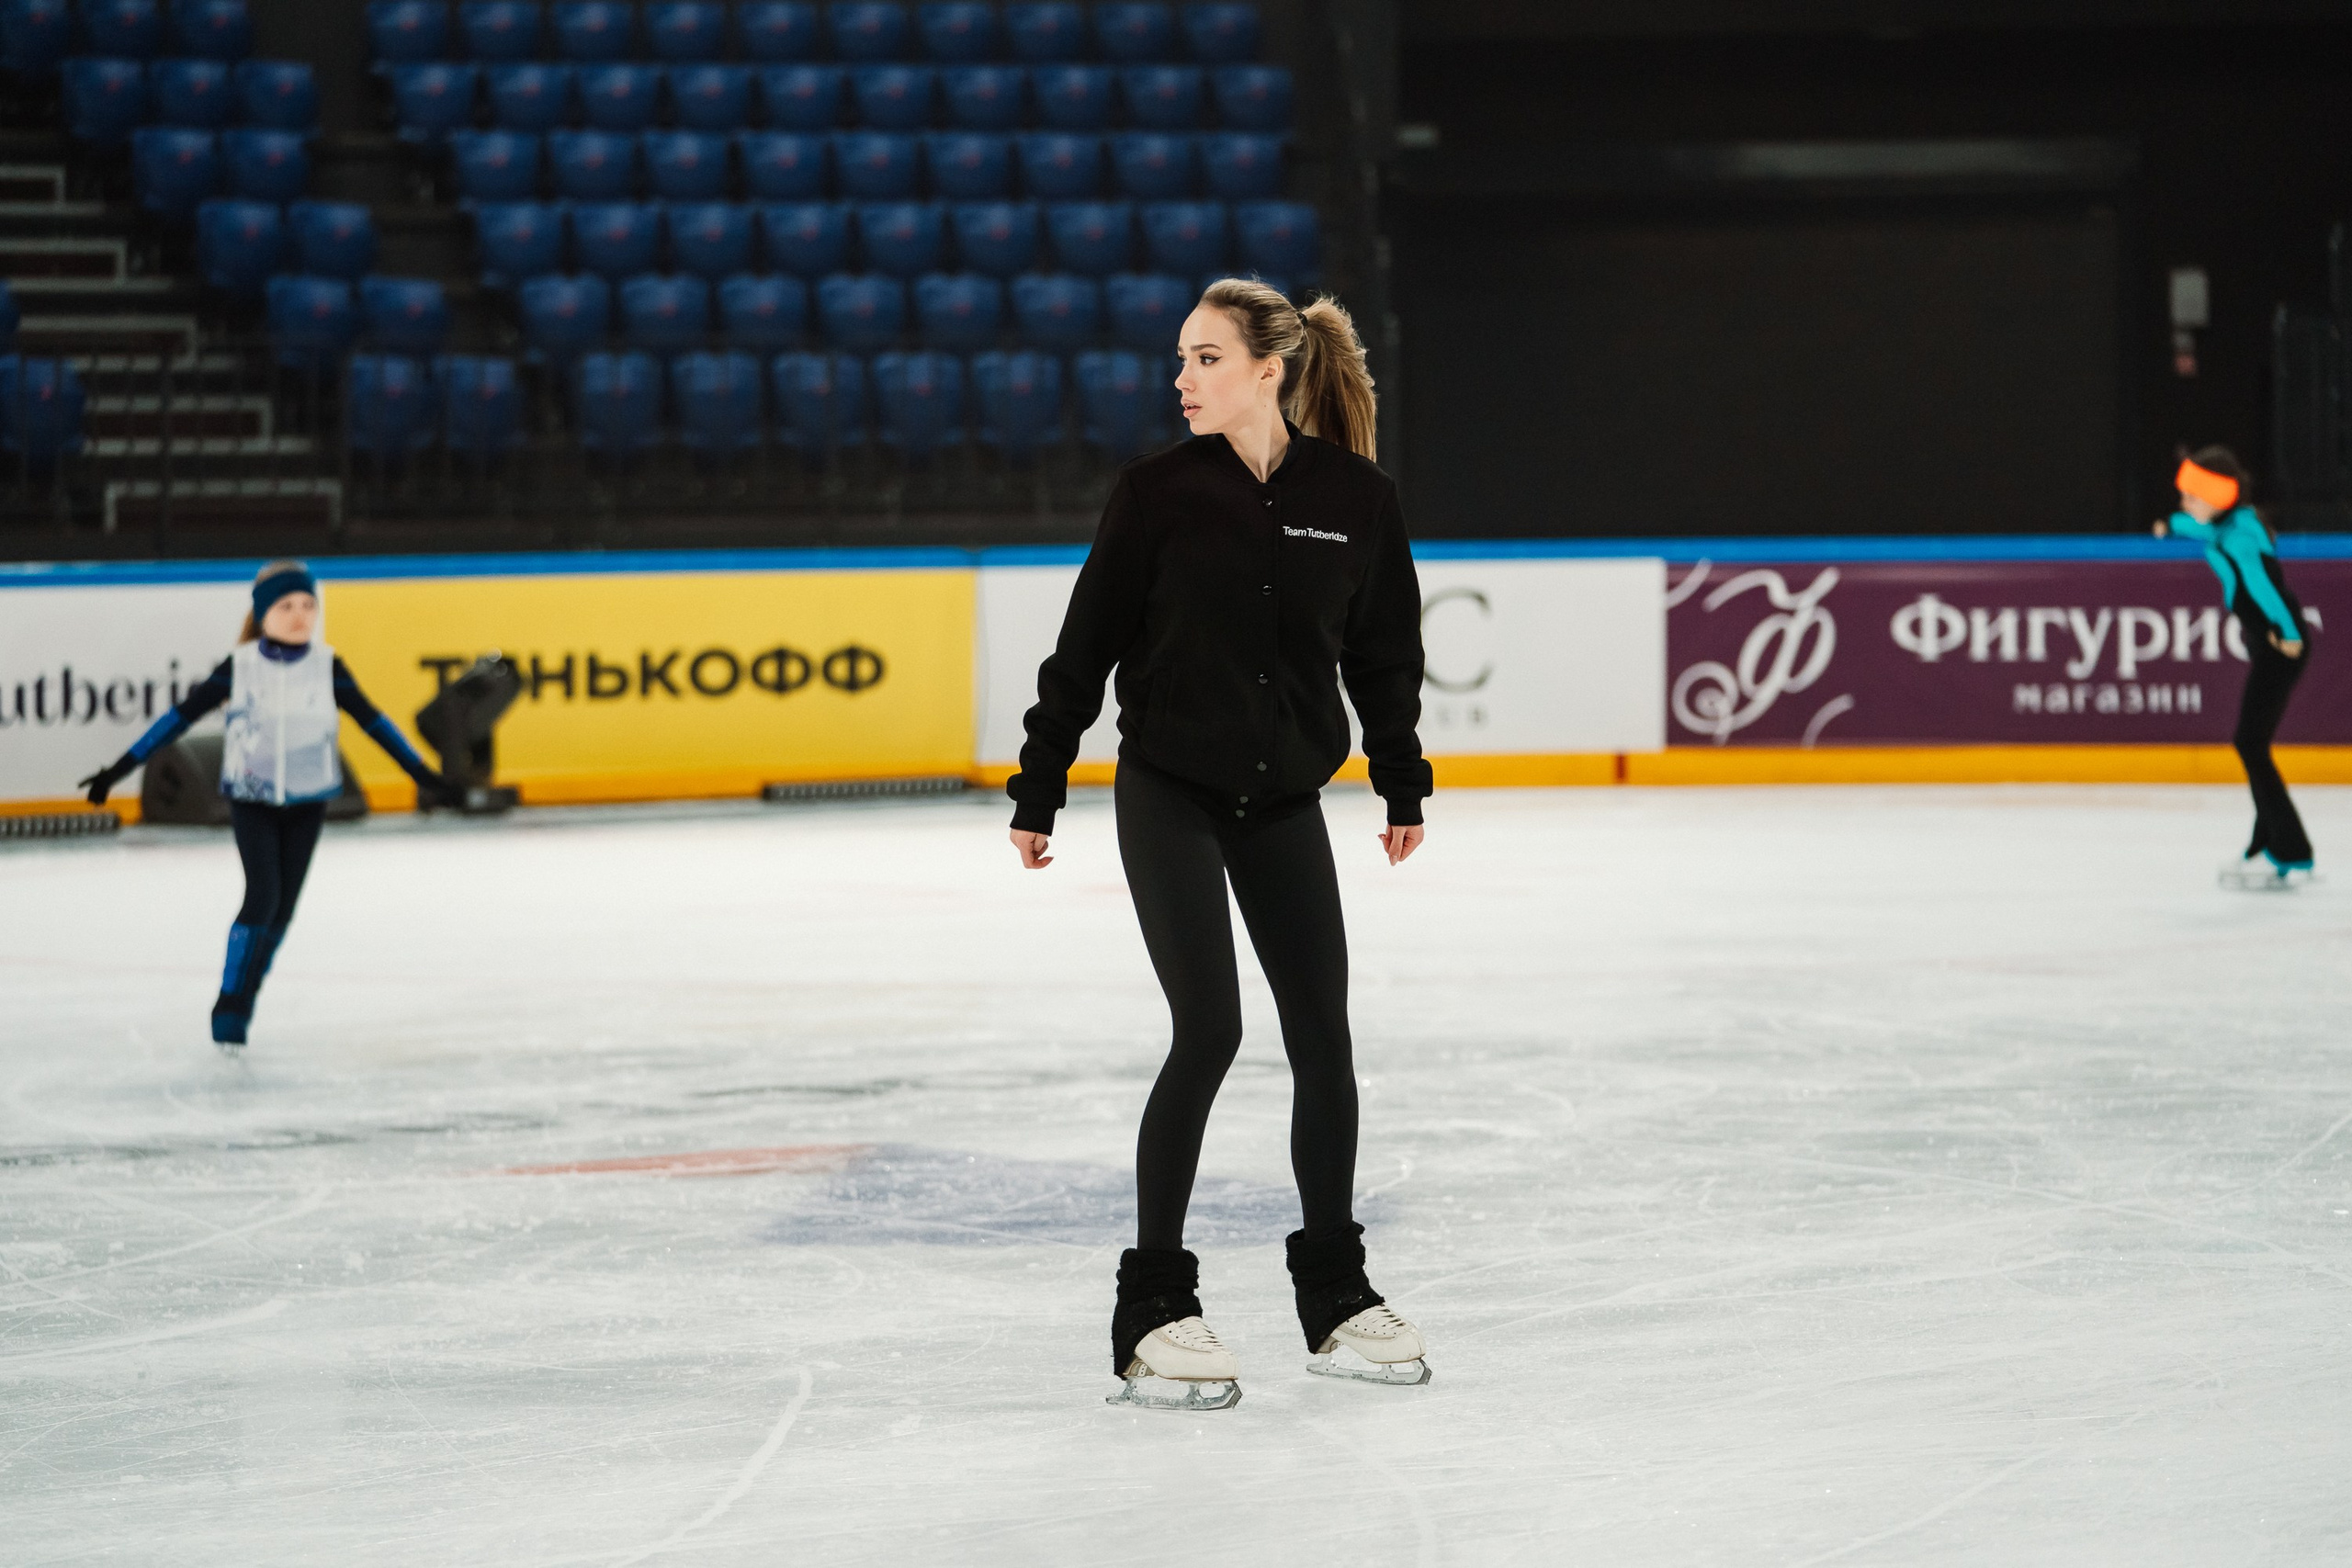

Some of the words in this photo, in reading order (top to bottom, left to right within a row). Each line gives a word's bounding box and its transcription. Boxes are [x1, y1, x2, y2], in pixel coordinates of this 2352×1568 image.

[1283, 525, 1306, 537] Team
[1891, 592, 2324, 681] Фигурис
[0, 657, 208, 727] utberi
[418, 641, 887, 702] ТНЬКОФФ
